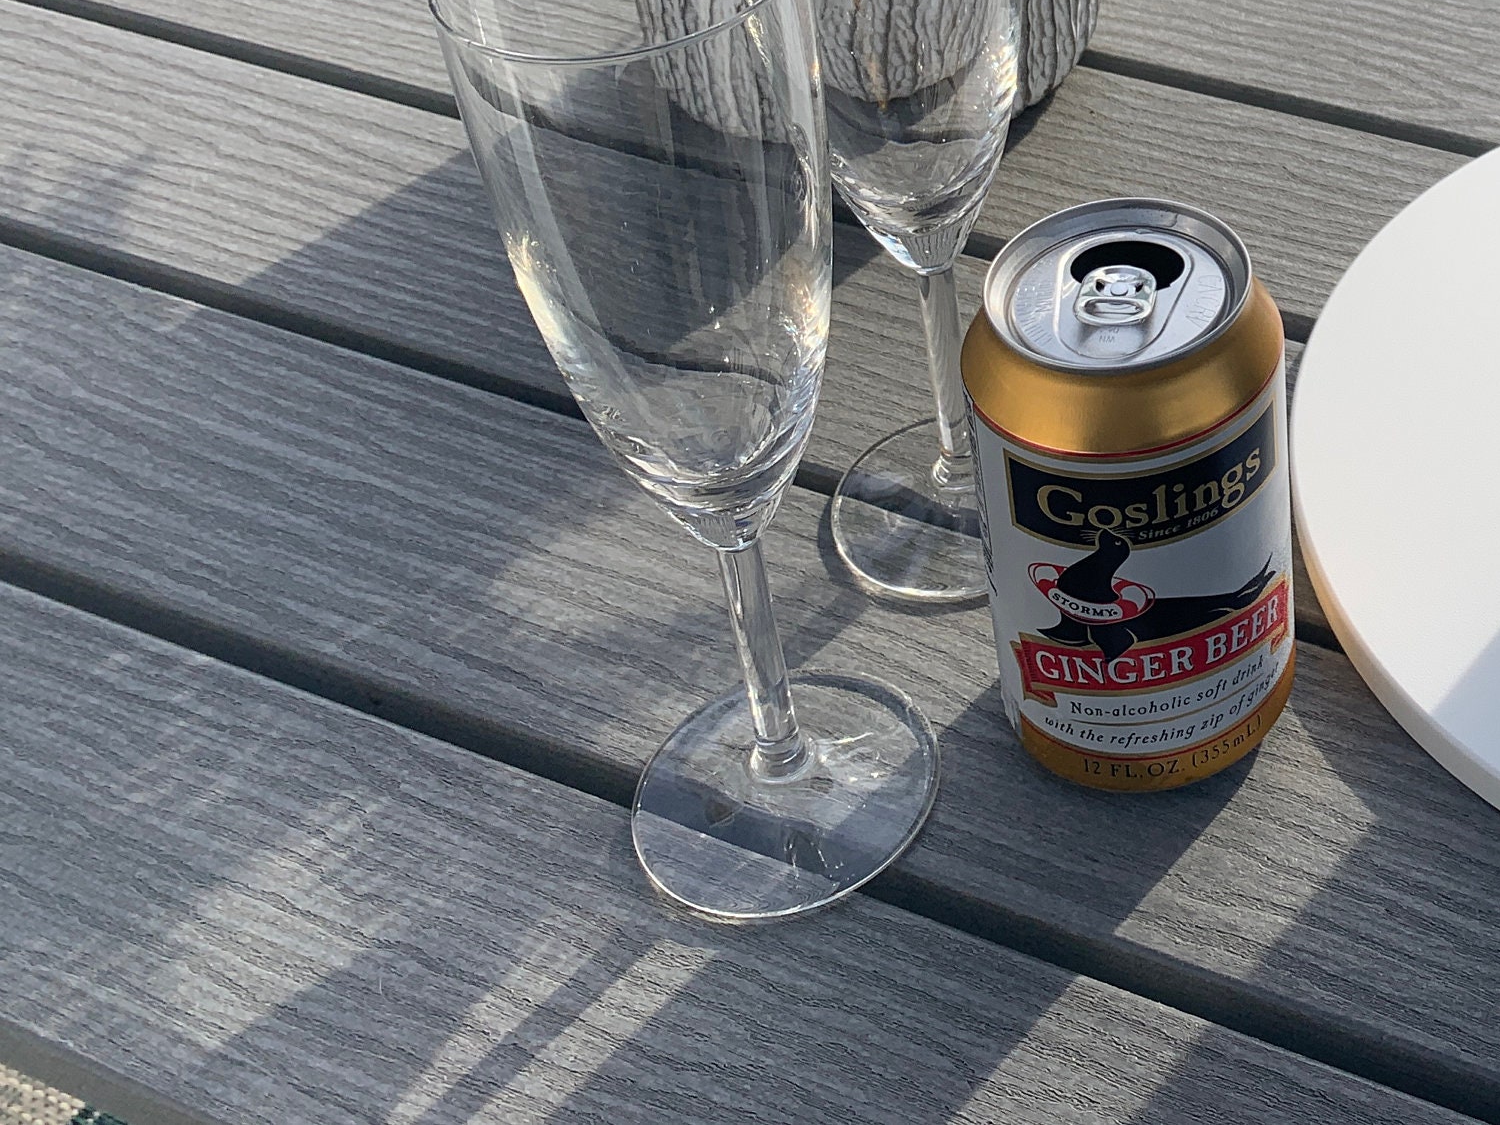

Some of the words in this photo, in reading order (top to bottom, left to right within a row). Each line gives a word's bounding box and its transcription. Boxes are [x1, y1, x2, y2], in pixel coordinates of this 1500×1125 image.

[1036, 447, 1262, 529] Goslings
[1138, 523, 1181, 541] Since
[1185, 508, 1220, 529] 1806
[1052, 592, 1116, 617] STORMY
[1034, 646, 1195, 685] GINGER
[1203, 594, 1280, 665] BEER
[1070, 693, 1191, 717] Non-alcoholic
[1196, 678, 1228, 700] soft
[1232, 654, 1264, 685] drink
[1045, 716, 1075, 736] with
[1079, 726, 1104, 743] the
[1109, 723, 1196, 749] refreshing
[1200, 713, 1224, 730] zip
[1229, 694, 1246, 716] of
[1083, 757, 1101, 775] 12
